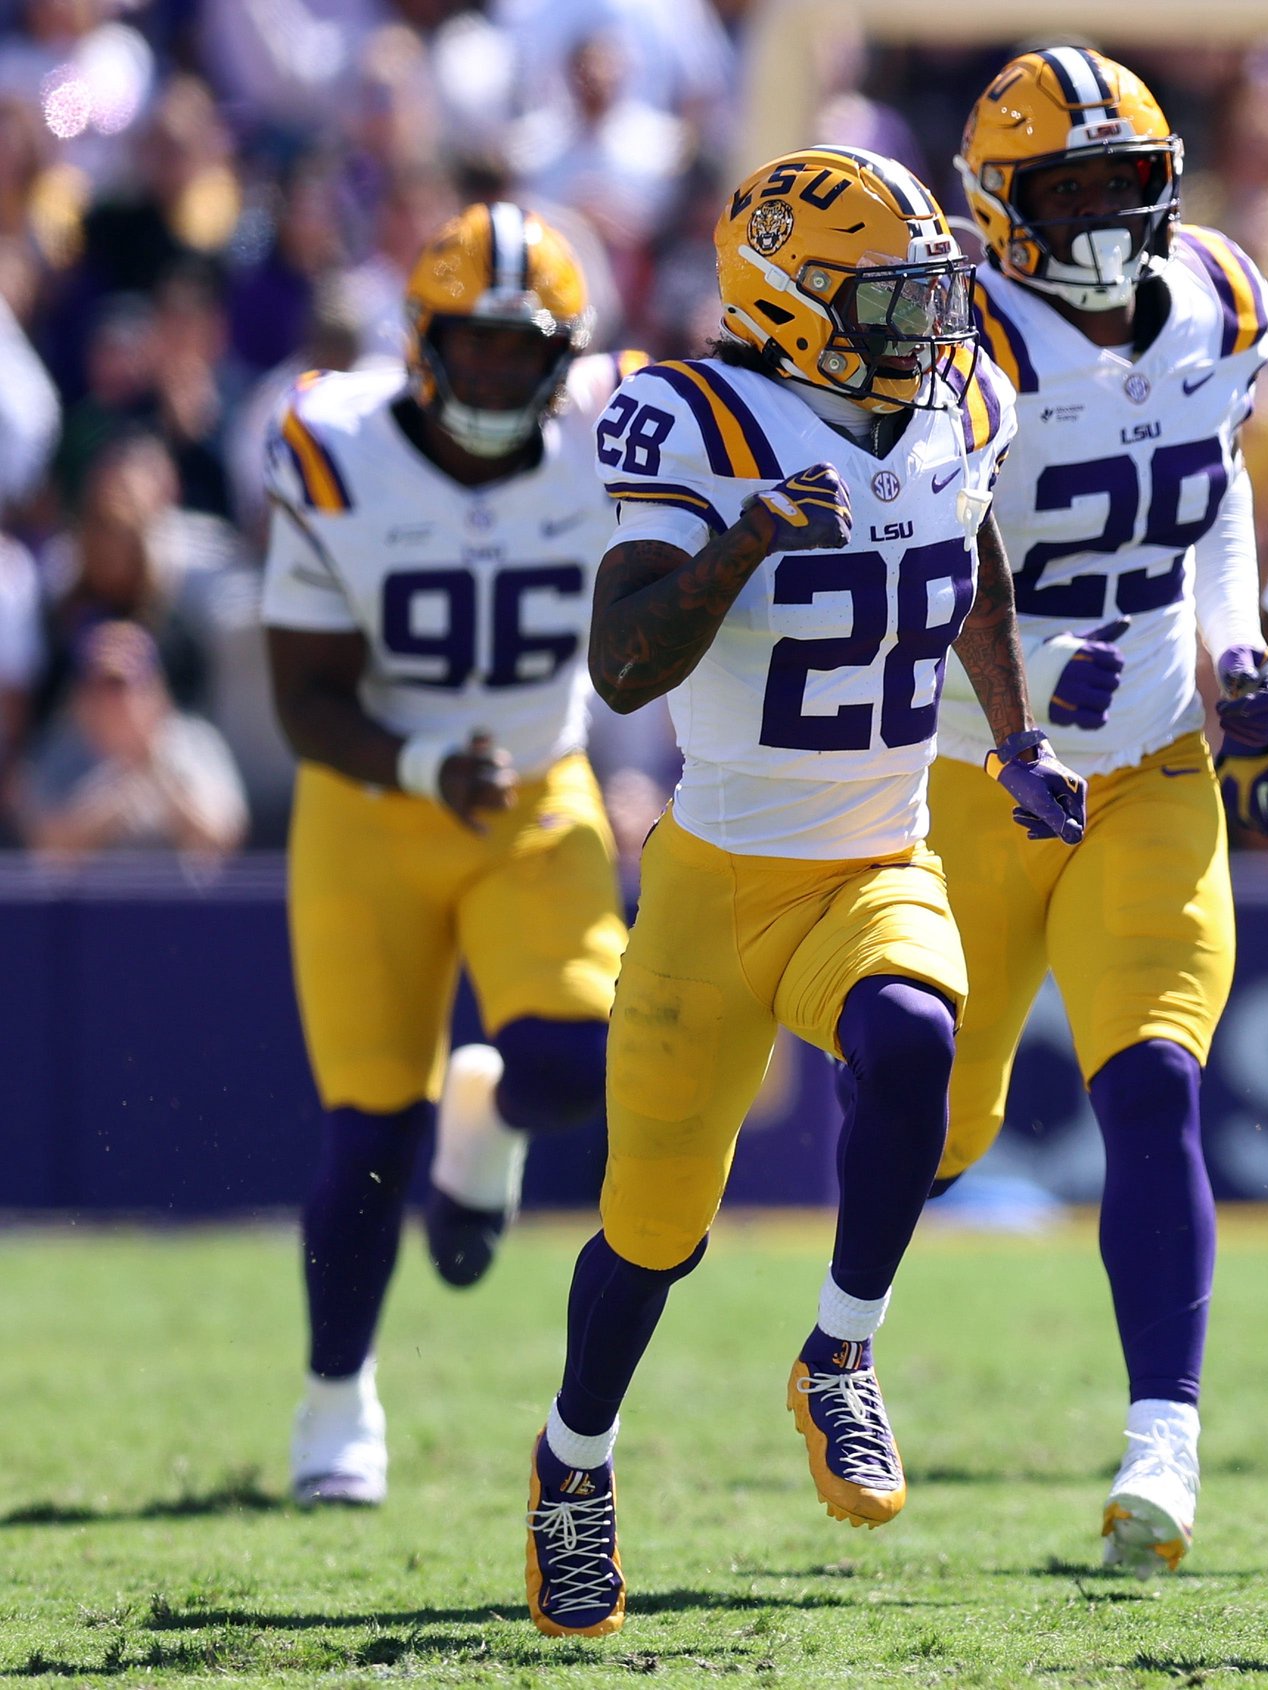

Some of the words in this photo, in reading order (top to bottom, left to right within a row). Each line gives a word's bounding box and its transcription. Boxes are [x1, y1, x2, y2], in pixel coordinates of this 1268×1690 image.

[730, 163, 852, 221] LSU
[596, 393, 676, 476] 28
[1120, 420, 1161, 445] LSU
[874, 472, 898, 500] SEC
[869, 520, 913, 542] LSU
[1013, 435, 1228, 620] 29
[383, 564, 583, 689] 96
[759, 537, 976, 751] 28
